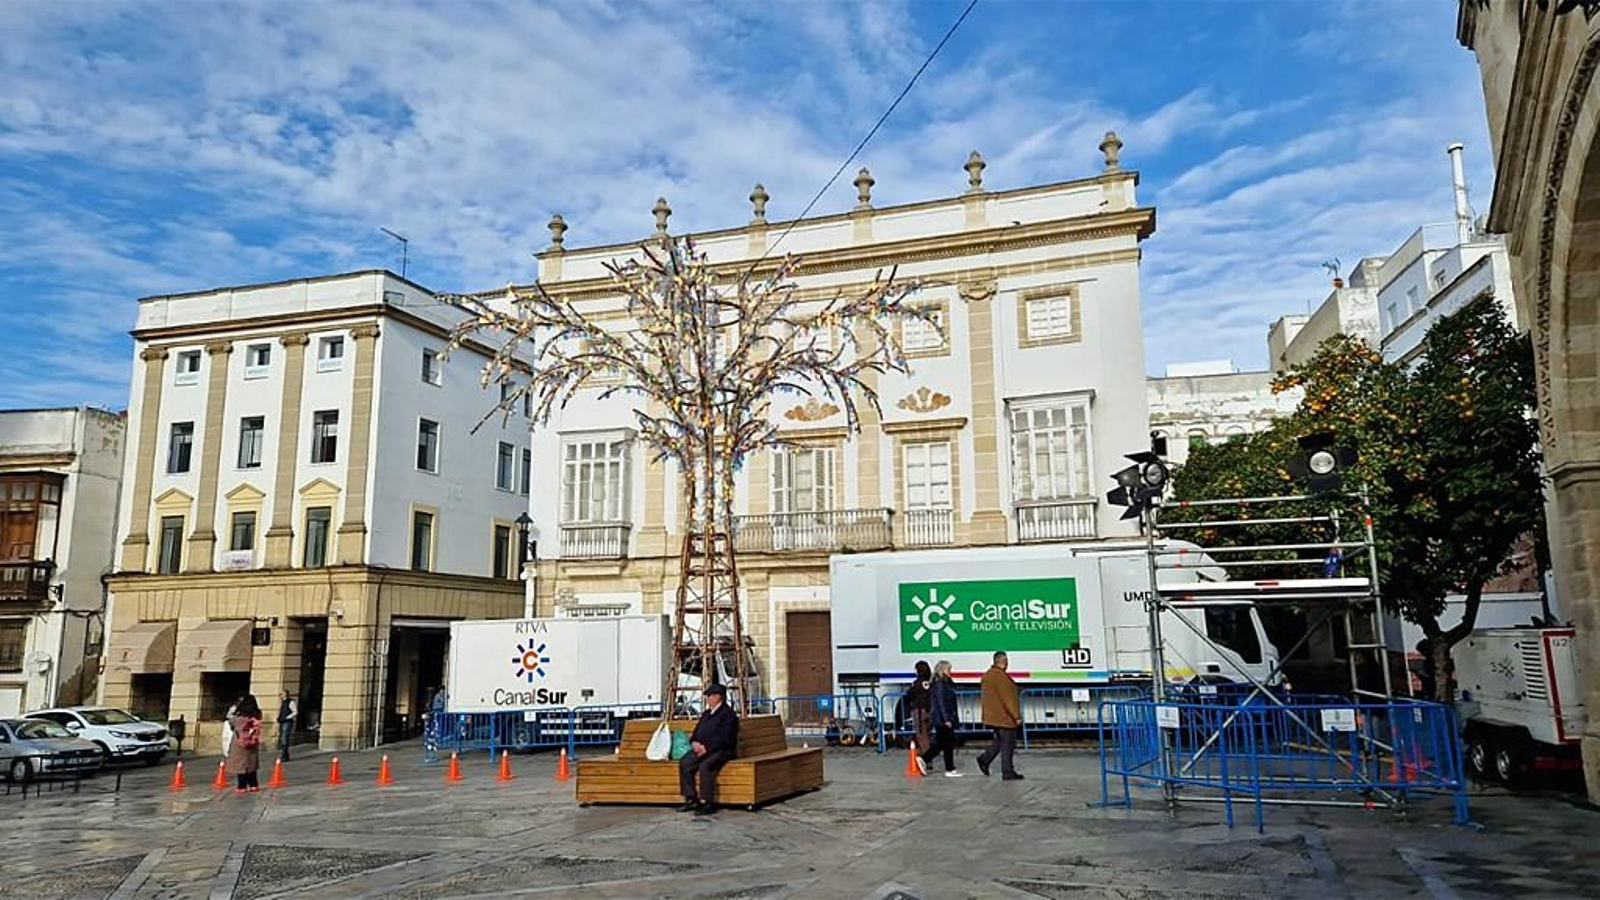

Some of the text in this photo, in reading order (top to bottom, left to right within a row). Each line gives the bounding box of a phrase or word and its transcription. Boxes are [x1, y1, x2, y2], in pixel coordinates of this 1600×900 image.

[515, 622, 548, 634] RTVA
[972, 619, 1073, 631] RADIO Y TELEVISIÓN
[1064, 649, 1090, 663] HD
